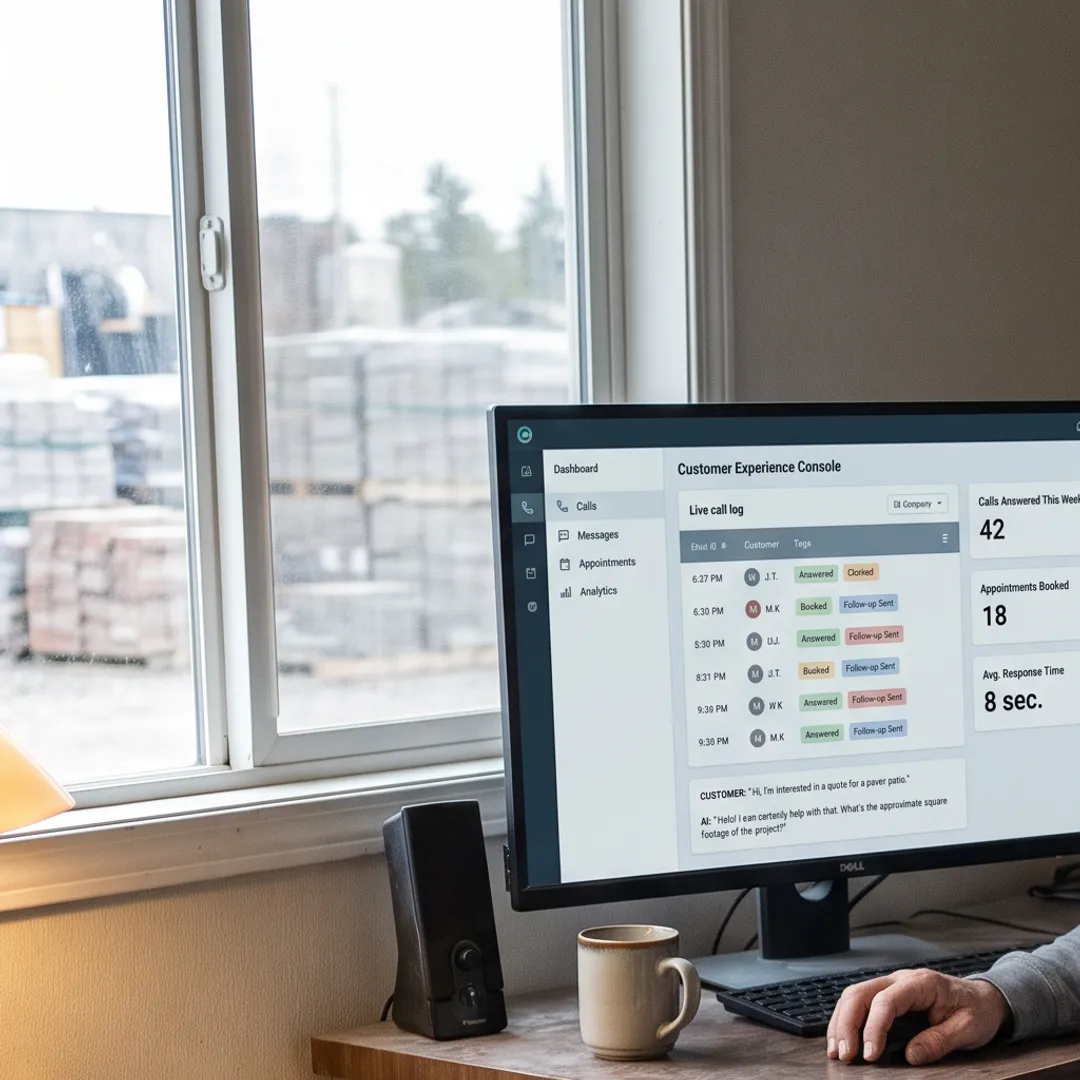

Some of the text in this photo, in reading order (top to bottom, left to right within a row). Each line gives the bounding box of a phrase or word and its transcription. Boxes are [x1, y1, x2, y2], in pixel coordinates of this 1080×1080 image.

[554, 463, 598, 474] Dashboard
[678, 460, 841, 476] Customer Experience Console
[978, 496, 999, 506] Calls
[1001, 495, 1041, 506] Answered
[1042, 494, 1059, 504] This
[576, 501, 597, 511] Calls
[689, 504, 744, 516] Live call log
[980, 518, 1005, 540] 42
[578, 530, 619, 542] Messages
[744, 540, 779, 549] Customer
[579, 558, 636, 570] Appointments
[711, 574, 722, 582] PM
[580, 586, 618, 597] Analytics
[980, 580, 1069, 596] Appointments Booked
[878, 599, 894, 607] Sent
[693, 607, 724, 616] 6:30 PM
[983, 604, 1007, 626] 18
[801, 634, 836, 643] Answered
[884, 630, 899, 639] Sent
[713, 640, 725, 648] PM
[880, 662, 895, 670] Sent
[714, 672, 726, 680] PM
[983, 666, 1064, 681] Avg. Response Time
[984, 691, 1042, 712] 8 sec.
[805, 729, 839, 739] Answered
[717, 737, 728, 745] PM
[700, 789, 746, 800] CUSTOMER:
[776, 783, 811, 794] interested
[827, 781, 847, 791] quote
[849, 779, 859, 788] for
[867, 779, 886, 788] paver
[701, 817, 711, 826] AI:
[790, 809, 804, 819] help
[806, 807, 821, 817] with
[840, 804, 864, 814] What's
[866, 803, 877, 811] the
[924, 797, 947, 806] square
[701, 830, 729, 839] footage
[731, 827, 739, 836] of
[741, 827, 752, 835] the
